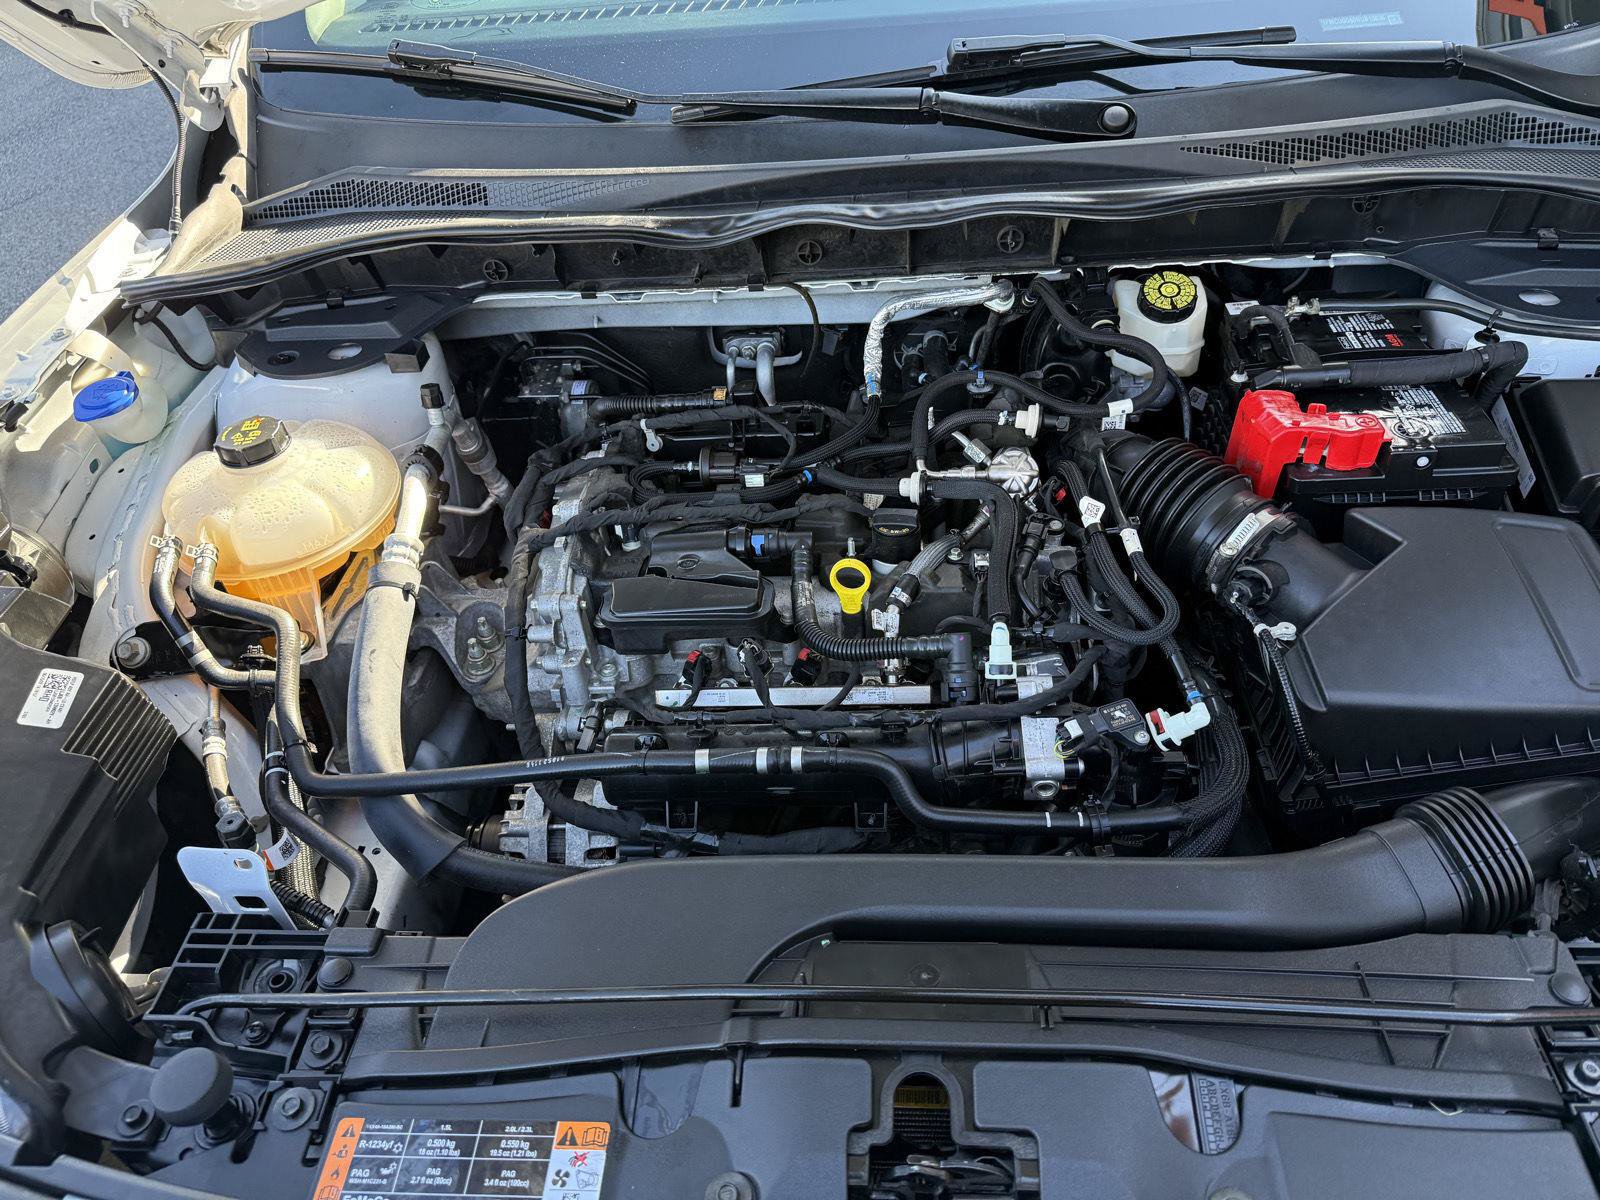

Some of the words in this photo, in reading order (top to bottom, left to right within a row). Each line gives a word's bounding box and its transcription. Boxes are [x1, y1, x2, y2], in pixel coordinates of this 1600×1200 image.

[359, 1140, 394, 1150] R-1234yf
[427, 1139, 446, 1147] 0.500
[446, 1139, 456, 1148] kg
[501, 1140, 520, 1148] 0.550
[520, 1140, 530, 1150] kg
[350, 1169, 370, 1177] PAG
